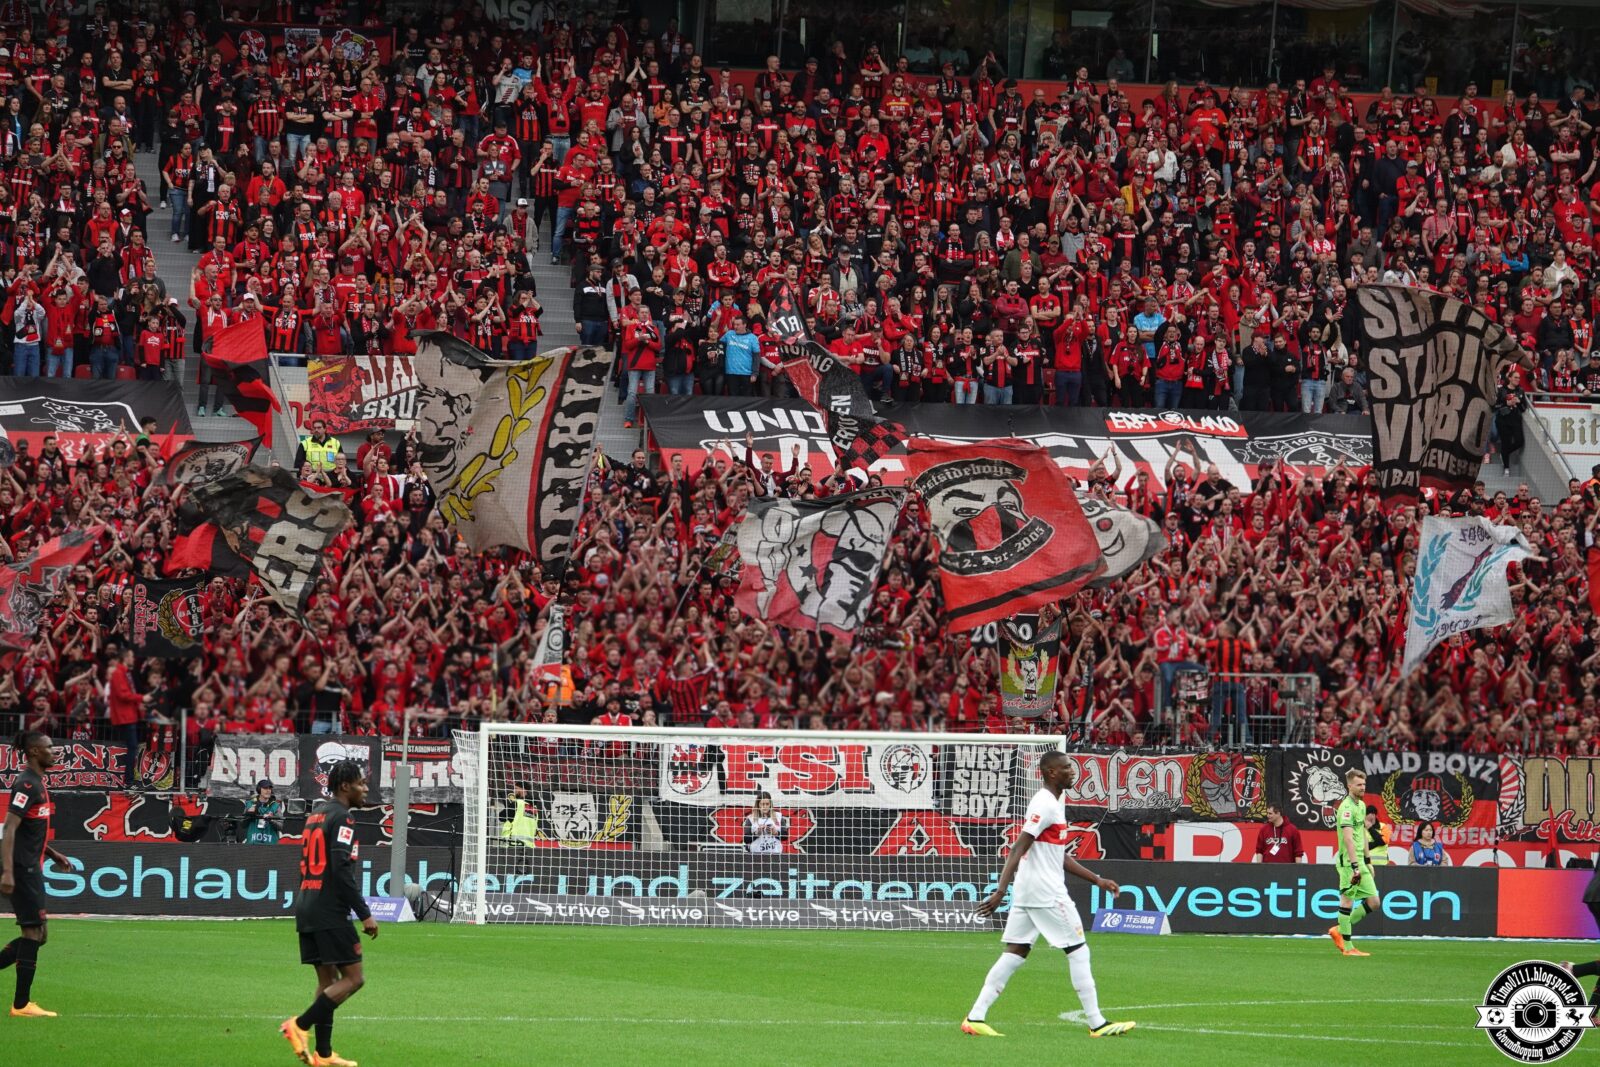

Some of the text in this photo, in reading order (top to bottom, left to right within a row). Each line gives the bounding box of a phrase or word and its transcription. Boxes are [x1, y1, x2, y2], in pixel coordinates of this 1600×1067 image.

[1192, 415, 1240, 433] LAND
[1291, 436, 1327, 448] 1904
[1013, 526, 1046, 553] 2005
[211, 747, 297, 787] BRO
[955, 745, 1011, 770] WEST
[1362, 751, 1498, 783] MAD BOYZ
[952, 769, 1011, 796] SIDE
[951, 795, 1012, 818] BOYZ
[43, 855, 1462, 921] Schlau, icher und zeitgemä investieen
[556, 902, 611, 918] trive
[648, 903, 704, 920] trive
[746, 905, 800, 922] trive
[842, 906, 895, 923] trive
